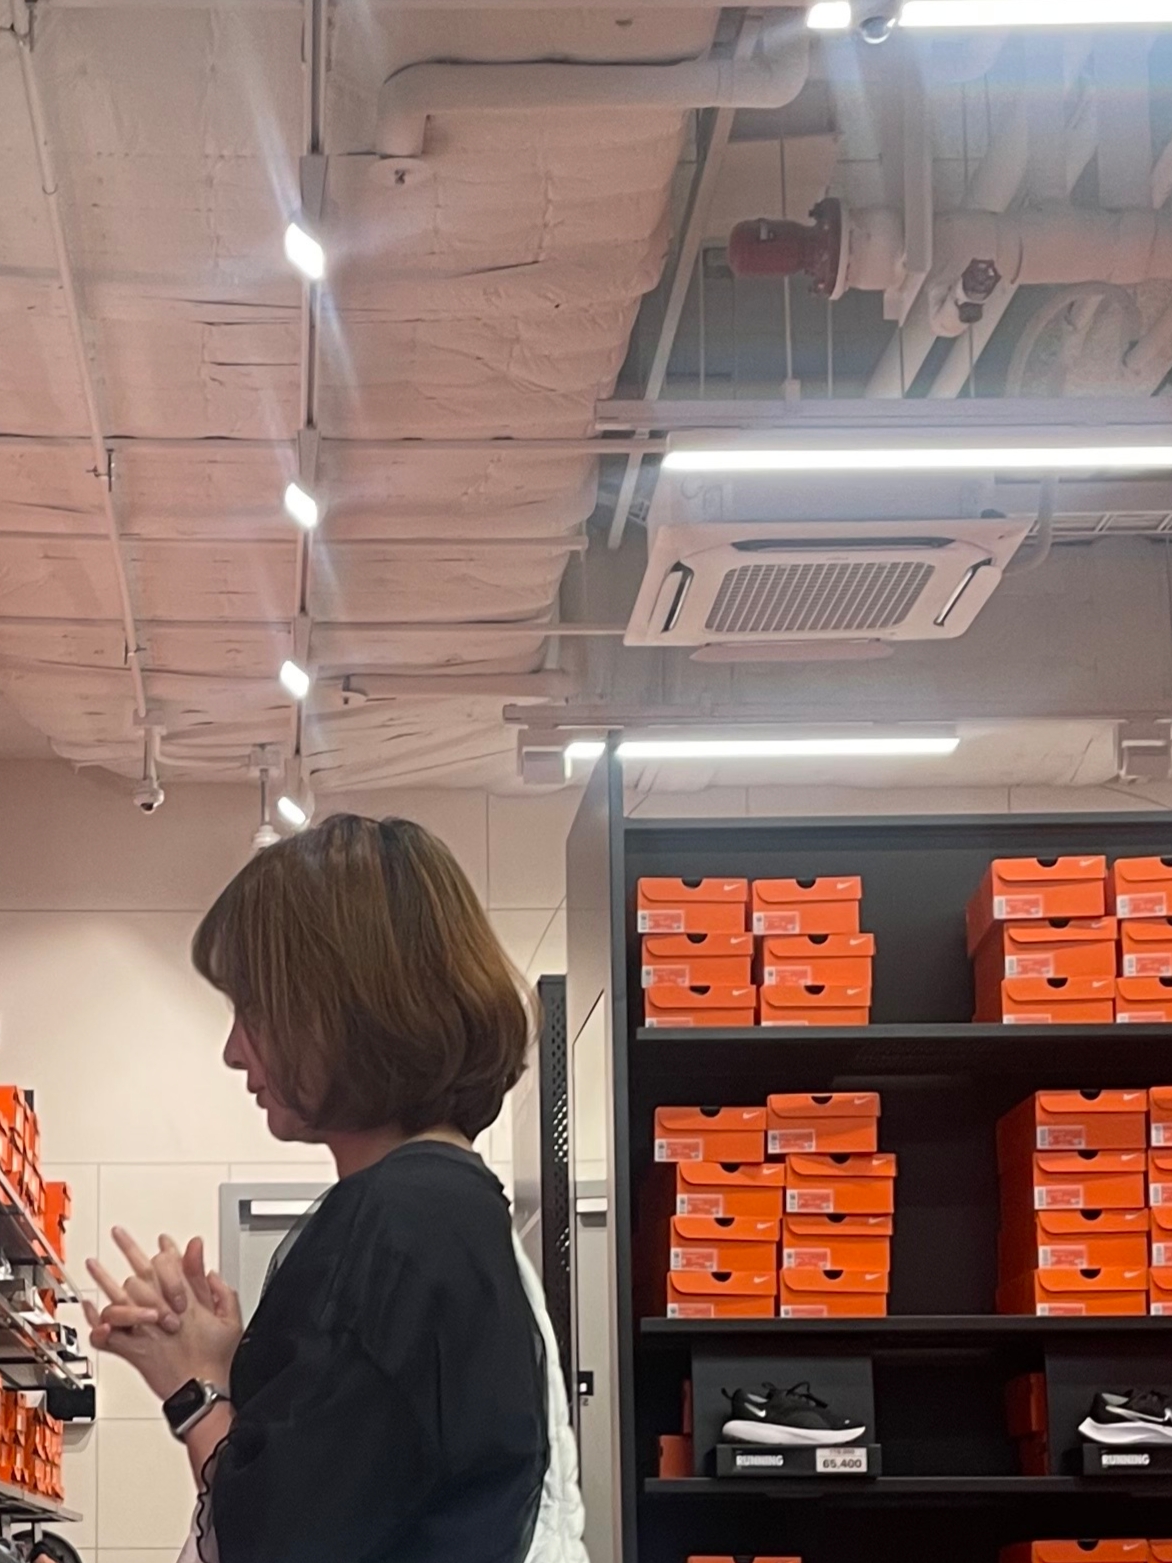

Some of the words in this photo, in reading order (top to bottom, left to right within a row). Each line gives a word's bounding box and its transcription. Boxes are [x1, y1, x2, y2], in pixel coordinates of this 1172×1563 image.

[736, 1454, 784, 1467] RUNNING
[822, 1458, 863, 1470] 65,400
[1101, 1453, 1151, 1466] RUNNING
